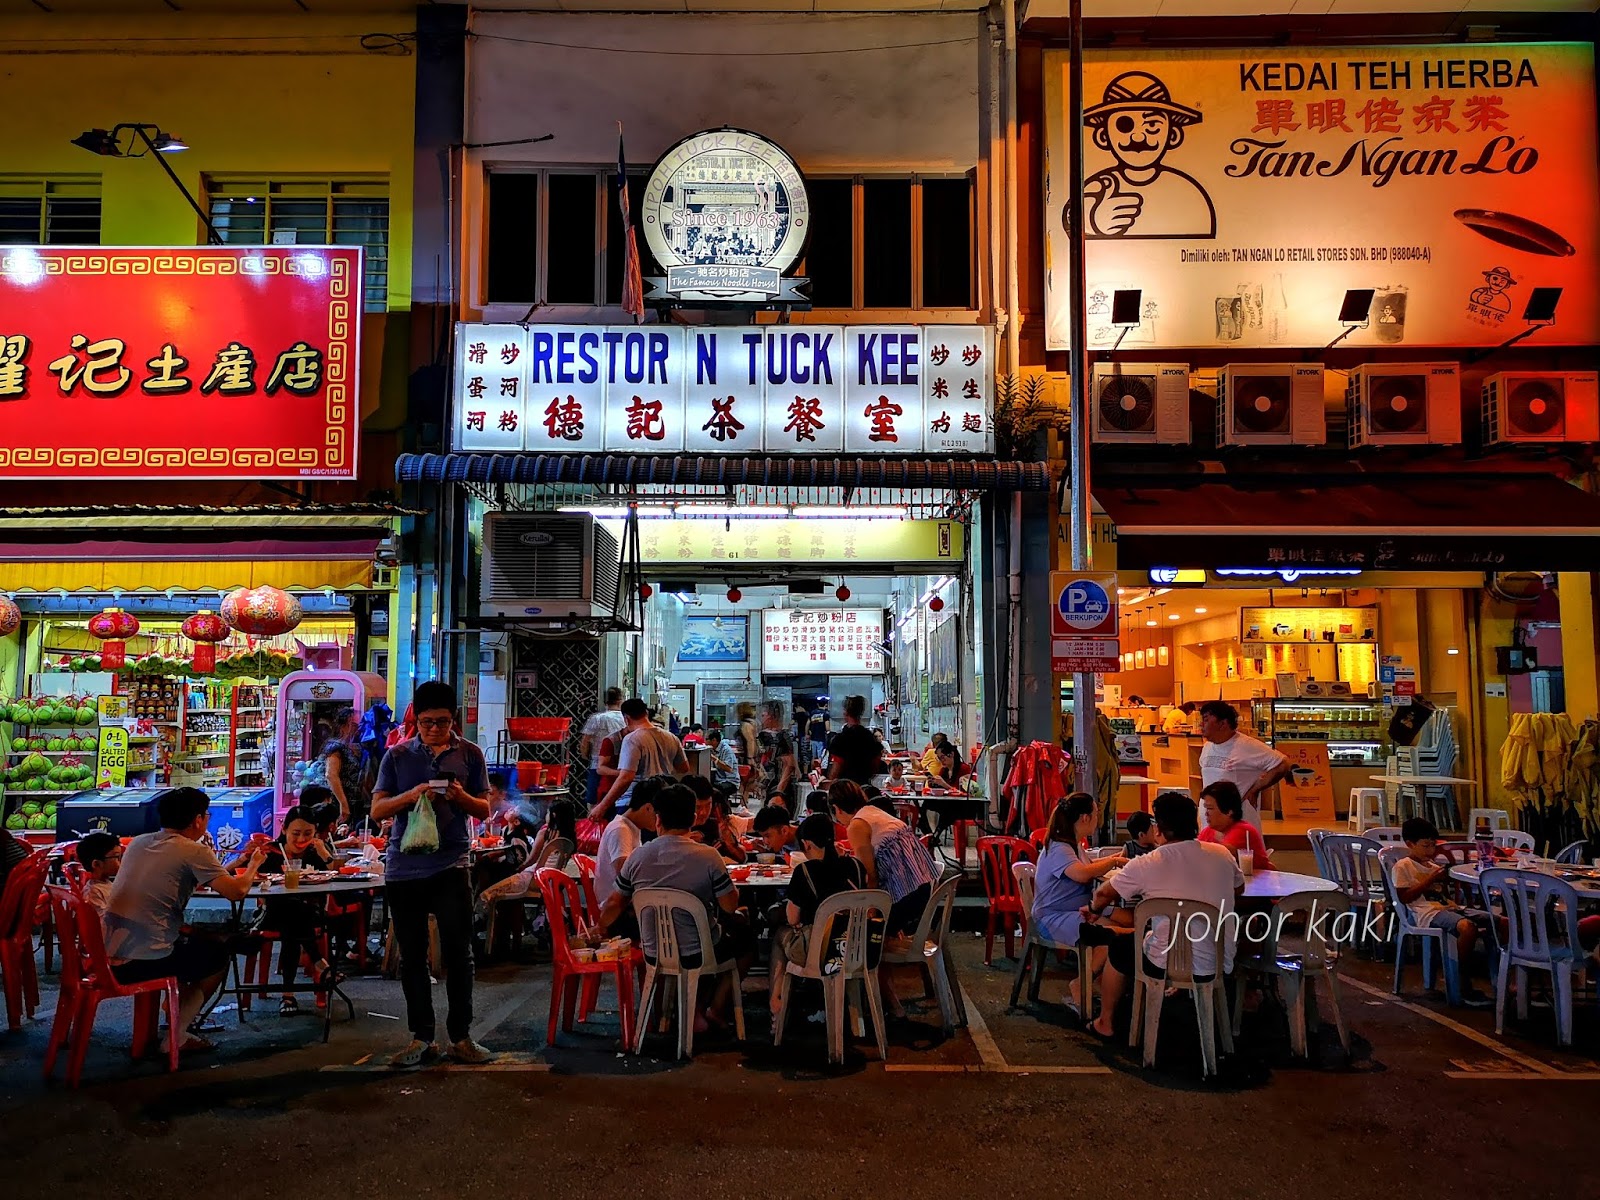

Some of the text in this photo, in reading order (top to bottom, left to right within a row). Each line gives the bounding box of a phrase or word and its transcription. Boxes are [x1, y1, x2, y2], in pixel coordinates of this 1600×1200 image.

[1239, 58, 1539, 91] KEDAI TEH HERBA
[646, 162, 673, 212] IPOH
[673, 135, 727, 162] TUCK
[735, 136, 777, 161] KEE
[1224, 135, 1539, 188] Tan Ngan Lo
[672, 209, 780, 229] Since 1963
[1181, 249, 1209, 262] Dimiliki
[1211, 249, 1230, 262] oleh:
[1232, 248, 1248, 262] TAN
[1250, 248, 1273, 261] NGAN
[1275, 248, 1285, 261] LO
[1287, 248, 1315, 261] RETAIL
[1317, 248, 1348, 261] STORES
[1350, 247, 1369, 261] SDN.
[1371, 247, 1388, 261] BHD
[672, 277, 776, 288] The Famous Noodle House
[743, 333, 834, 385] TUCK
[858, 333, 918, 385] KEE
[466, 342, 488, 432] 滑蛋河
[497, 342, 520, 432] 炒河粉
[543, 394, 903, 442] 德記茶餐室
[728, 551, 739, 559] 61
[1068, 589, 1087, 613] P
[101, 756, 124, 767] EGG
[1300, 748, 1306, 758] 5
